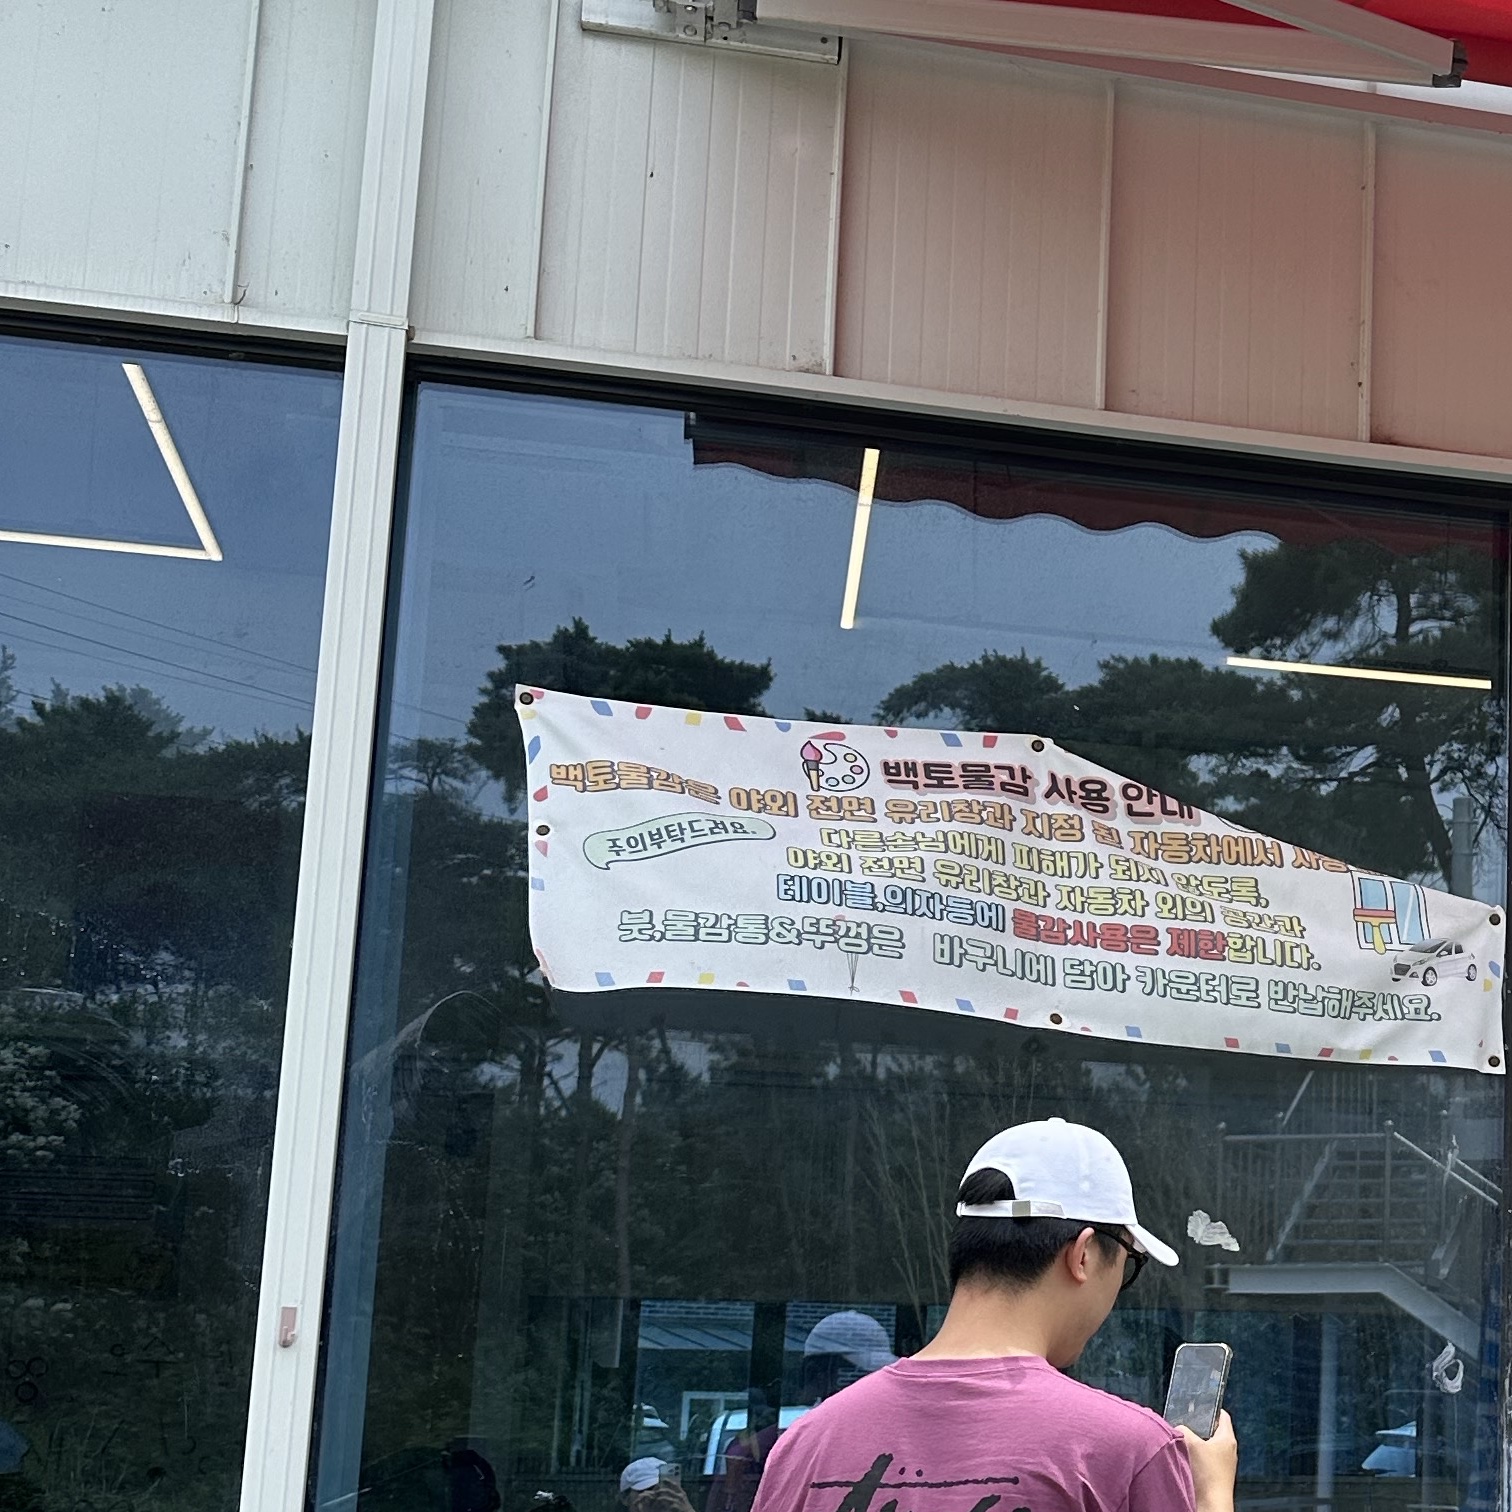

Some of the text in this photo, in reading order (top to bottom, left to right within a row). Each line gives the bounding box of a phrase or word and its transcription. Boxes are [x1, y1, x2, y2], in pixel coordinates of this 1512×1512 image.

[882, 758, 1034, 799] 백토물감
[1043, 771, 1112, 815] 사용
[728, 786, 799, 818] 야외
[805, 794, 878, 823] 전면
[884, 799, 1017, 833] 유리창과
[1020, 808, 1085, 843] 지정
[1091, 819, 1125, 850] 된
[1127, 830, 1284, 868] 자동차에서
[786, 847, 1307, 939] 야외 전면 유리창과 자동차 외의 공간과
[1011, 842, 1103, 879] 피해가
[1108, 853, 1169, 887] 되지
[1011, 907, 1161, 956] 물감사용은
[1166, 926, 1322, 971] 제한합니다.
[931, 932, 1057, 987] 바구니에
[1062, 956, 1131, 994] 담아
[1134, 963, 1263, 1010] 카운터로
[1267, 979, 1442, 1023] 반납해주세요.
